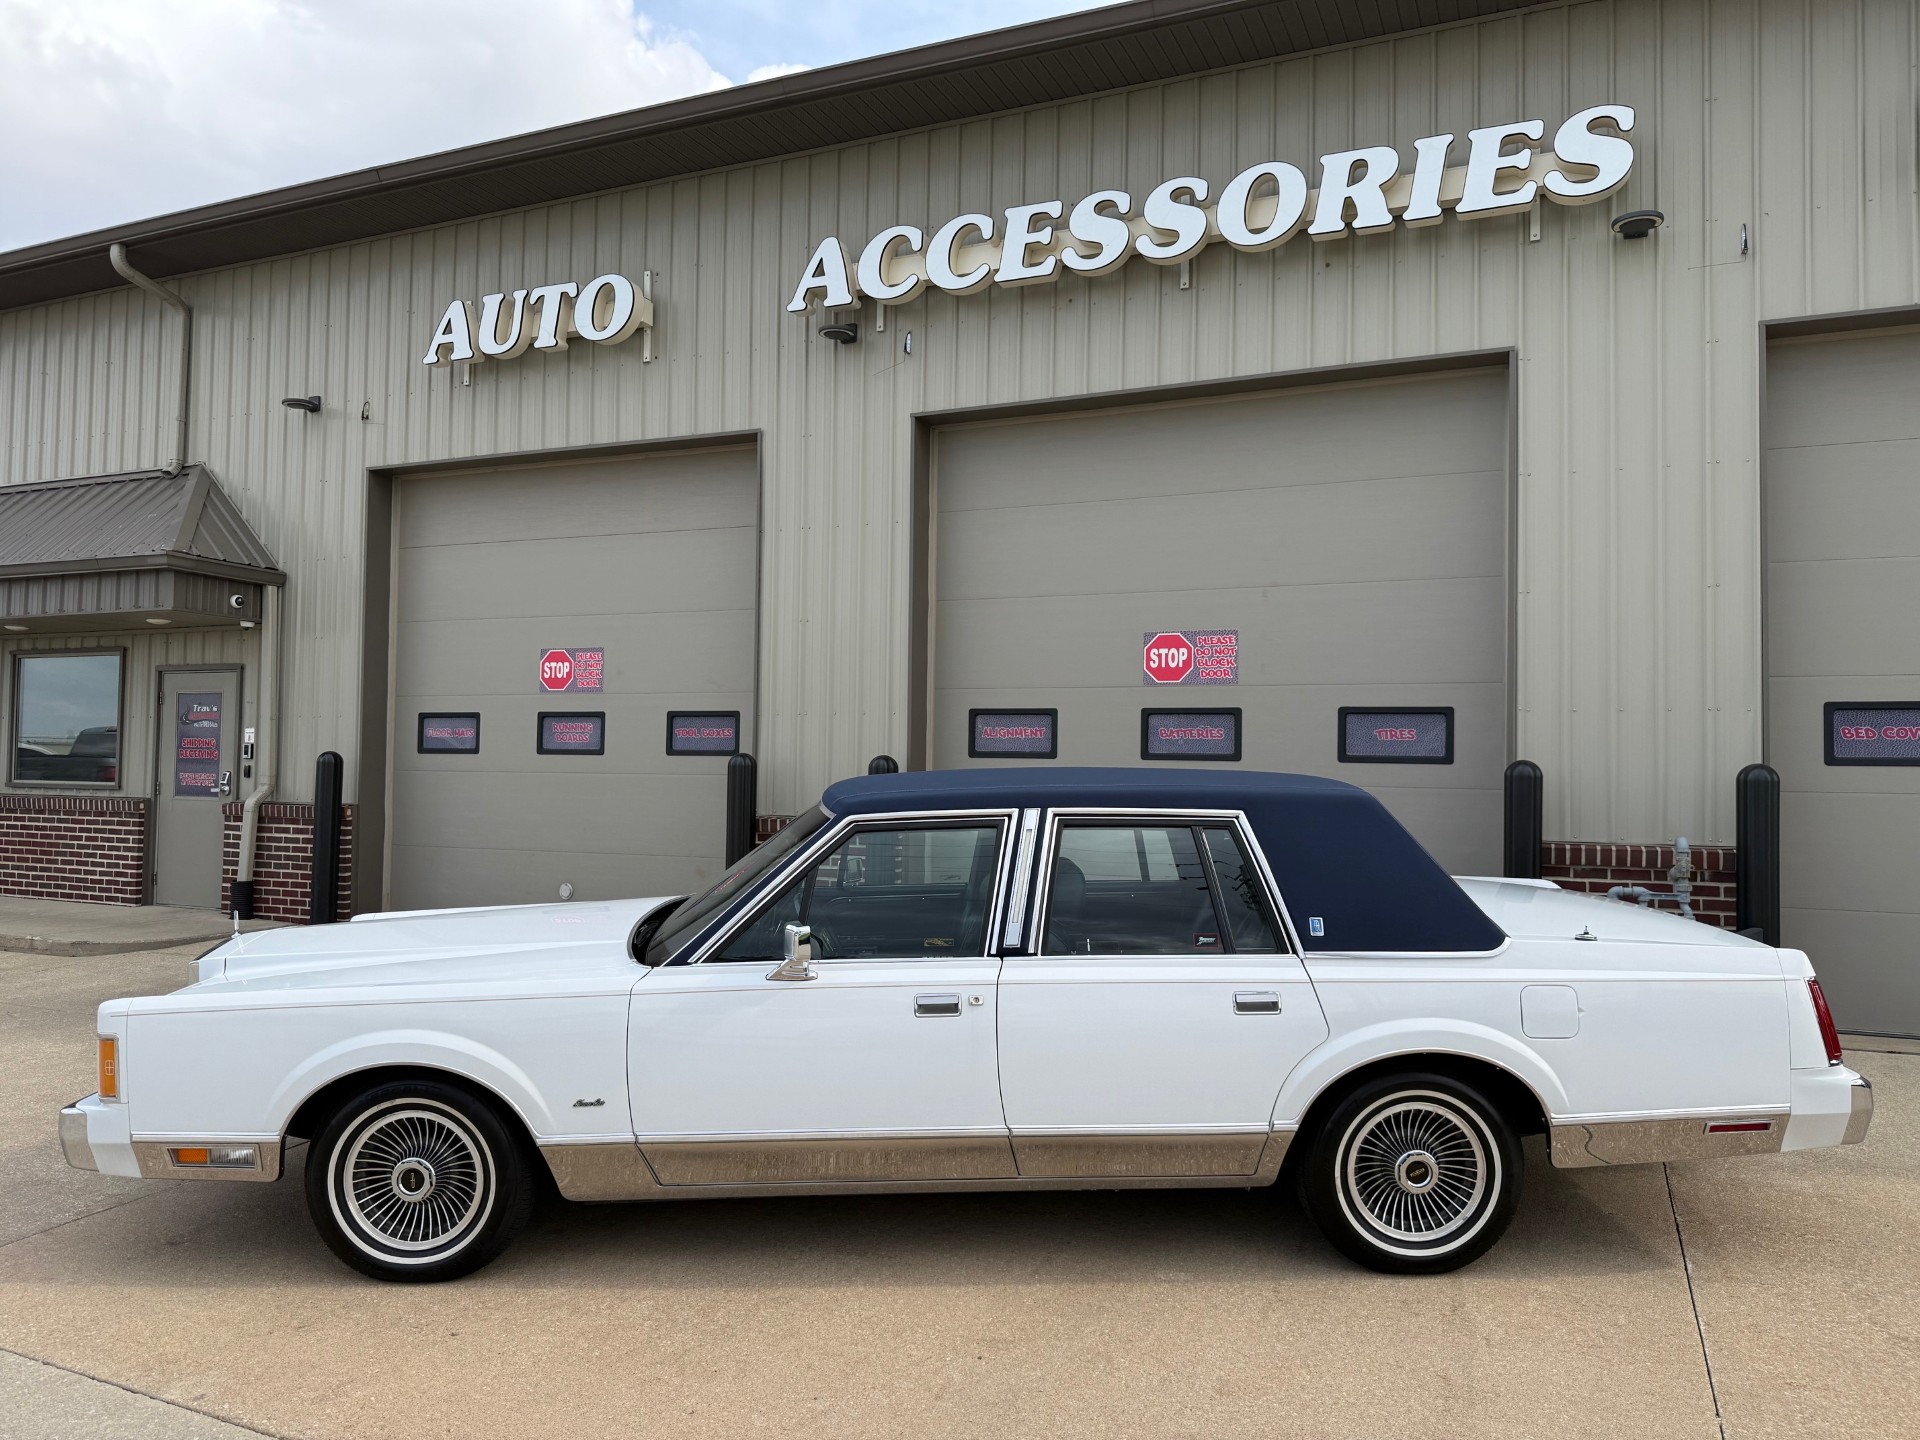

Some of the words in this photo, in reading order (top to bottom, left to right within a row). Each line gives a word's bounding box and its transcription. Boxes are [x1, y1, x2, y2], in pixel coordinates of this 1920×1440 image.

[422, 272, 636, 366] AUTO
[786, 103, 1637, 313] ACCESSORIES
[1196, 635, 1236, 647] PLEASE
[575, 651, 602, 661] PLEASE
[1195, 646, 1212, 657] DO
[1213, 646, 1238, 657] NOT
[1149, 647, 1188, 669] STOP
[1196, 657, 1236, 668] BLOCK
[543, 661, 570, 679] STOP
[575, 661, 586, 670] DO
[586, 661, 603, 670] NOT
[1200, 668, 1233, 679] DOOR
[577, 678, 600, 688] DOOR
[426, 727, 453, 738] FLOOR
[454, 727, 475, 738] MATS
[552, 722, 593, 733] RUNNING
[675, 727, 700, 738] TOOL
[701, 727, 733, 738] BOXES
[982, 726, 1046, 739] ALIGNMENT
[1840, 726, 1878, 740] BED
[555, 733, 590, 743] BOARDS
[1158, 727, 1224, 740] BATTERIES
[1374, 728, 1417, 741] TIRES
[182, 737, 216, 749] SHIPPING
[179, 749, 218, 760] RECEIVING
